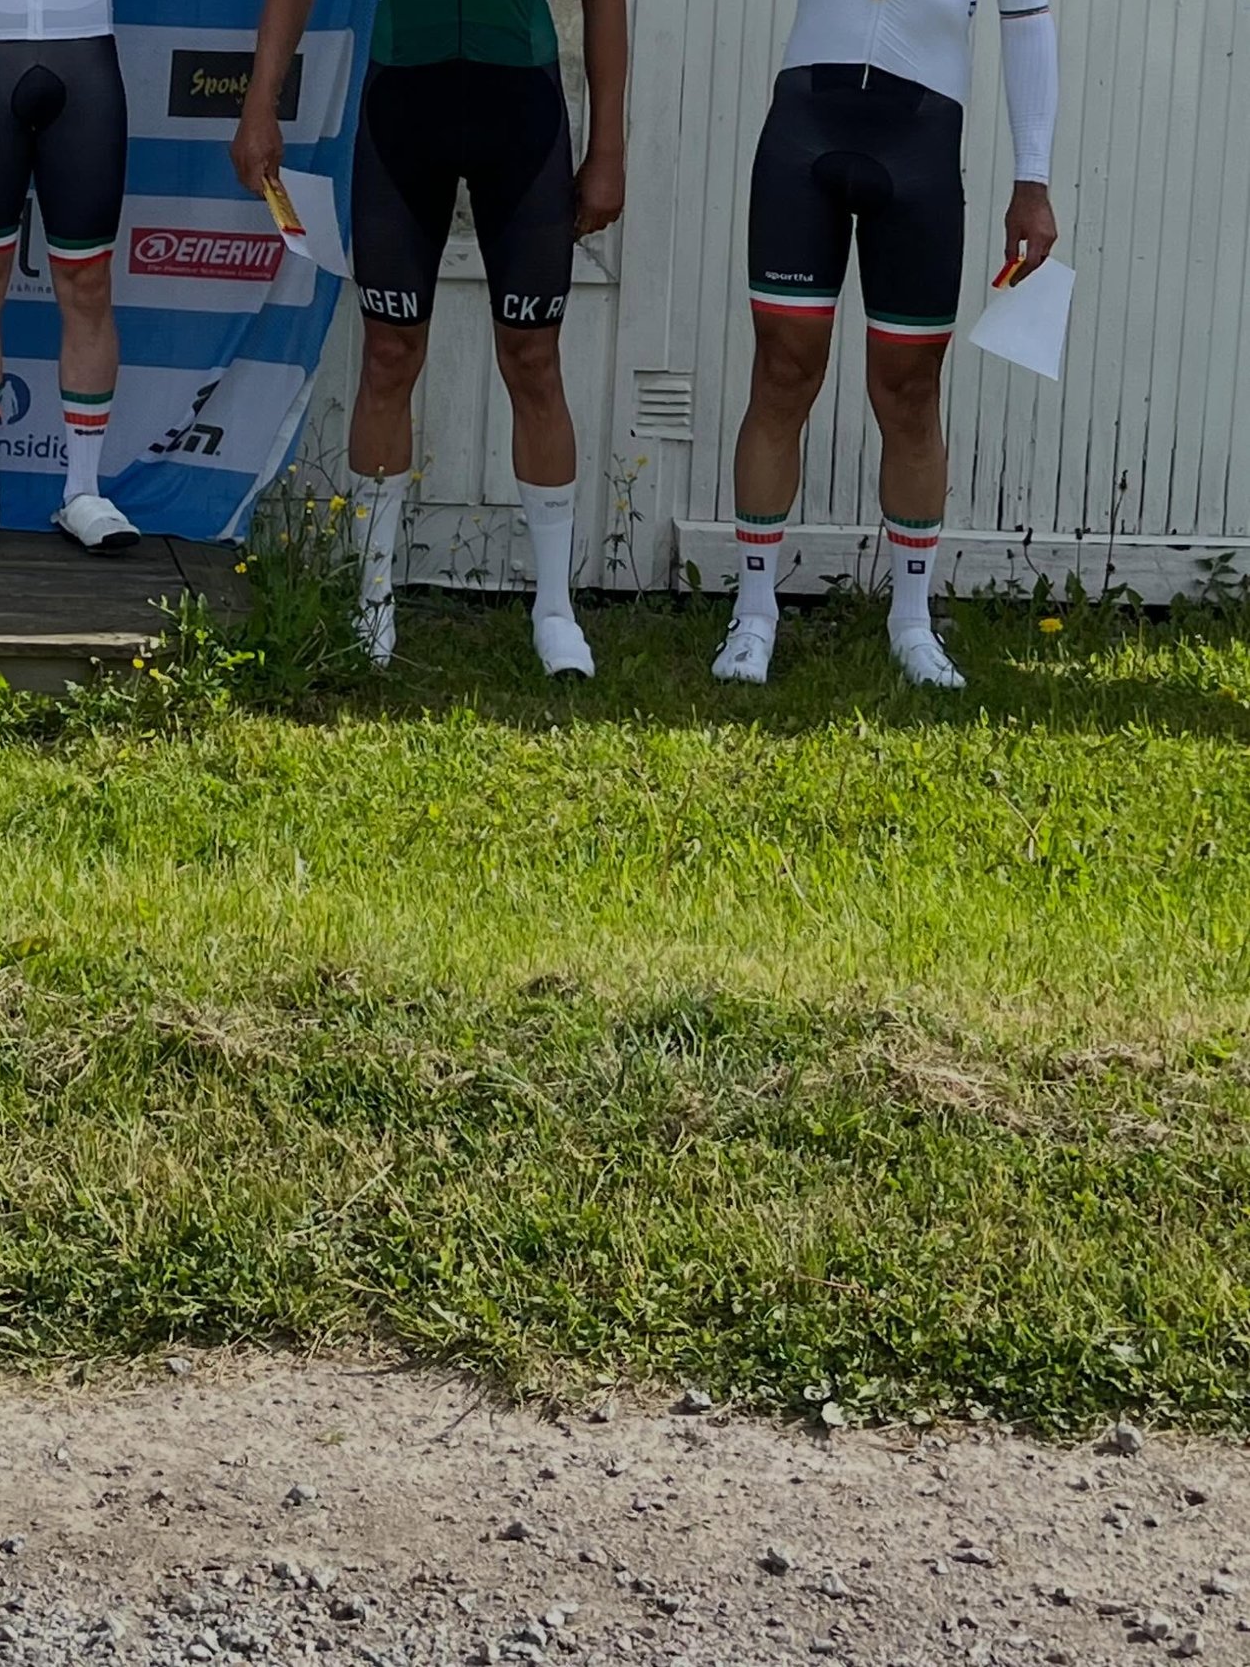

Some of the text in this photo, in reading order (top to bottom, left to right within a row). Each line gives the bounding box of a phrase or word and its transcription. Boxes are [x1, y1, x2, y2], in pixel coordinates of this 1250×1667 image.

[190, 68, 250, 98] Sport
[174, 236, 281, 267] ENERVIT
[764, 270, 815, 283] sportful
[503, 293, 542, 321] CK
